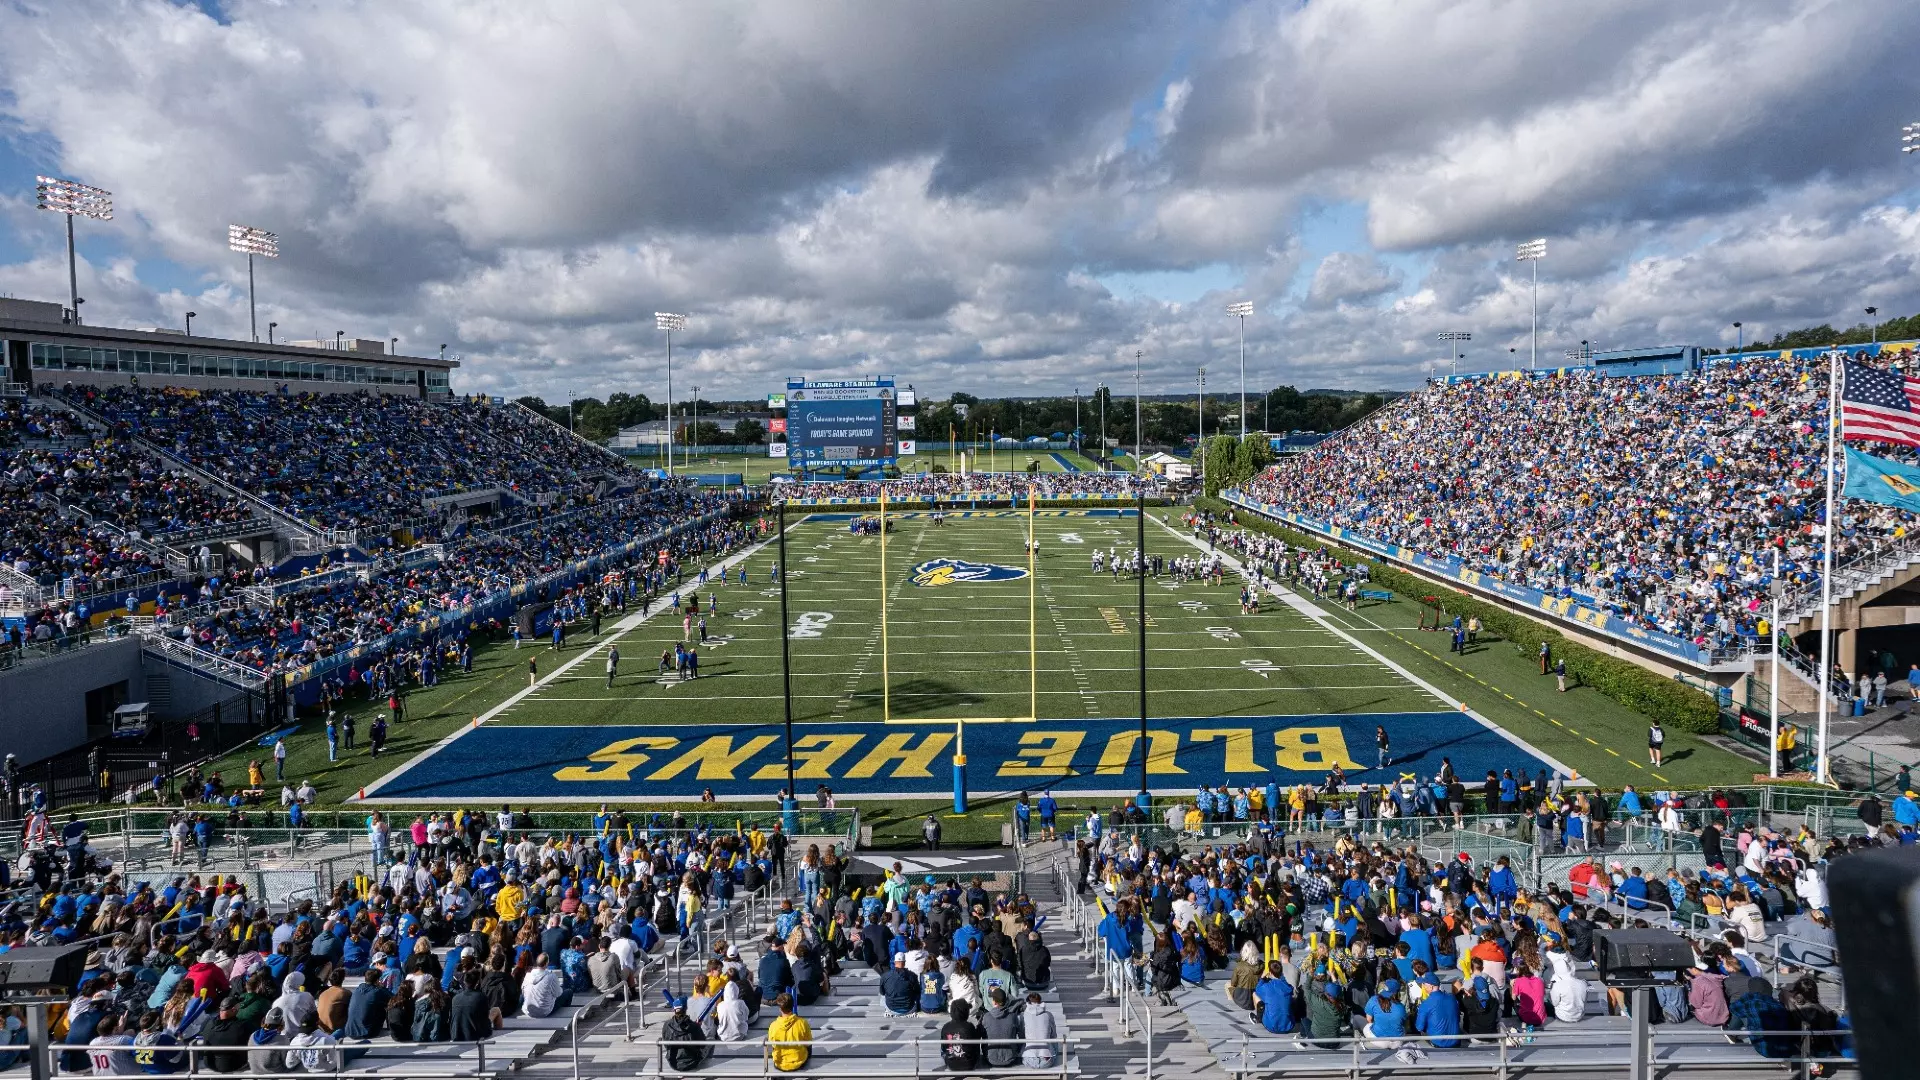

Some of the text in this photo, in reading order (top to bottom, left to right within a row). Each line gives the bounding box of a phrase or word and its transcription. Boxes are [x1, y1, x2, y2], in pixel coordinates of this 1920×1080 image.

[805, 449, 815, 458] 15
[1650, 635, 1681, 649] CHEVROLET
[1745, 721, 1774, 738] FLOSPO
[552, 726, 1370, 782] BLUE HENS
[93, 1054, 110, 1069] 10
